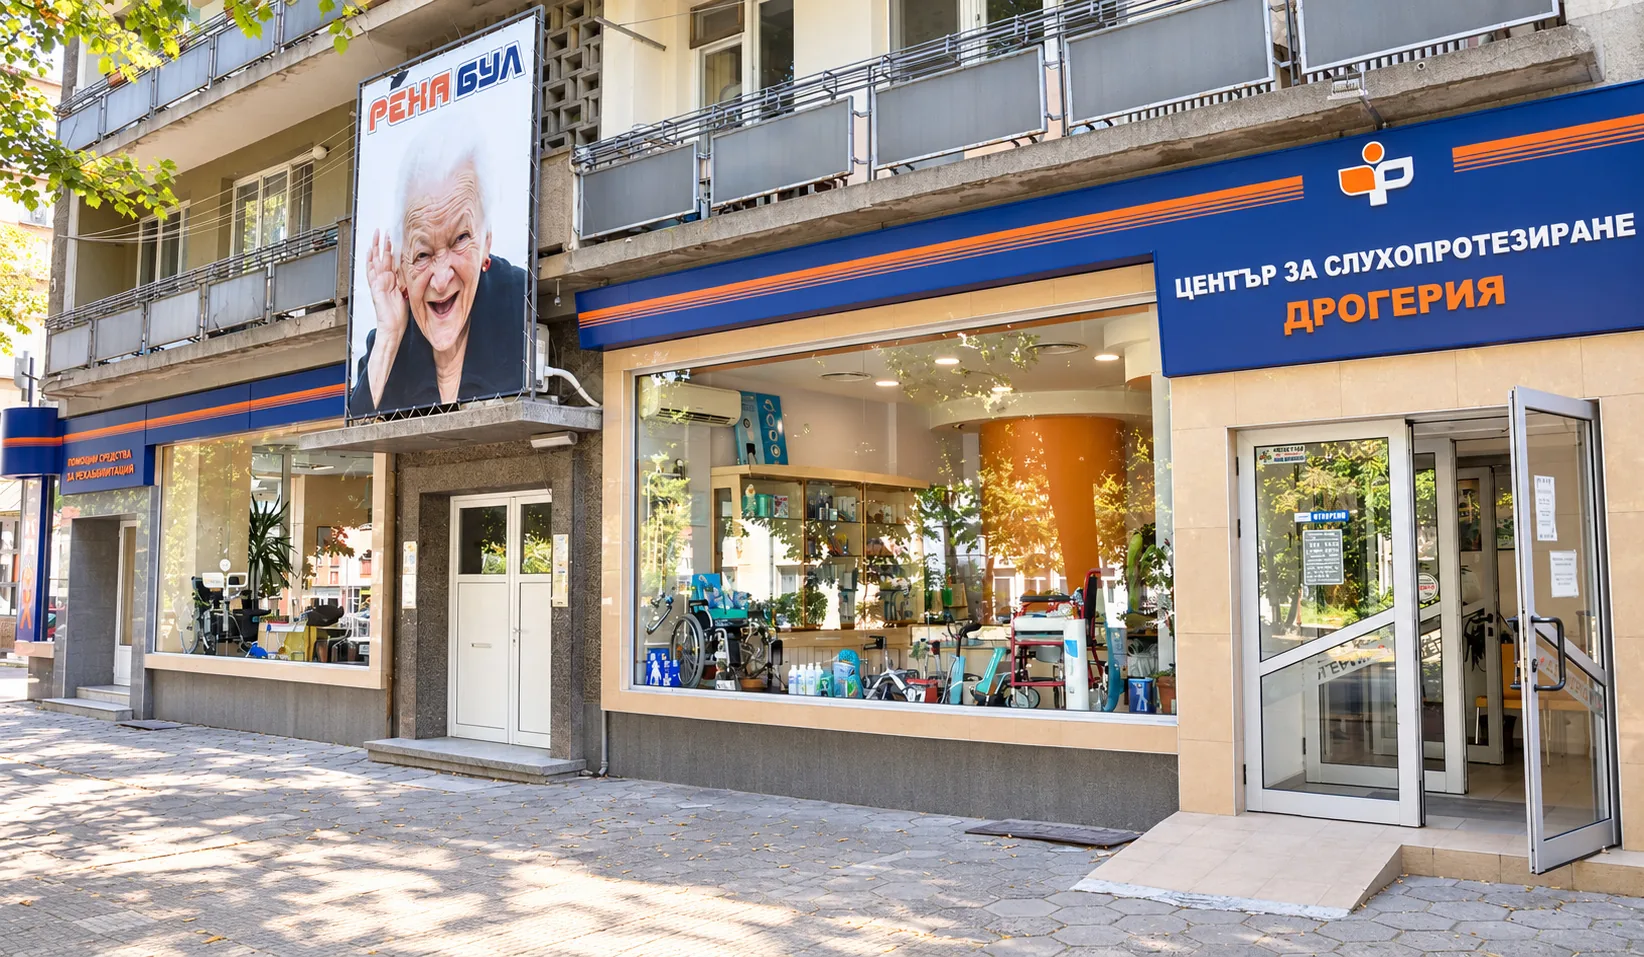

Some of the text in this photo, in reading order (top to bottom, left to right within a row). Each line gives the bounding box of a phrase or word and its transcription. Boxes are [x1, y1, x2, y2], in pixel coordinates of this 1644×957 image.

[368, 43, 523, 133] РЕХА БУЛ
[1174, 212, 1636, 300] ЦЕНТЪР ЗА СЛУХОПРОТЕЗИРАНЕ
[1283, 275, 1506, 336] ДРОГЕРИЯ
[99, 449, 132, 463] СРЕДСТВА
